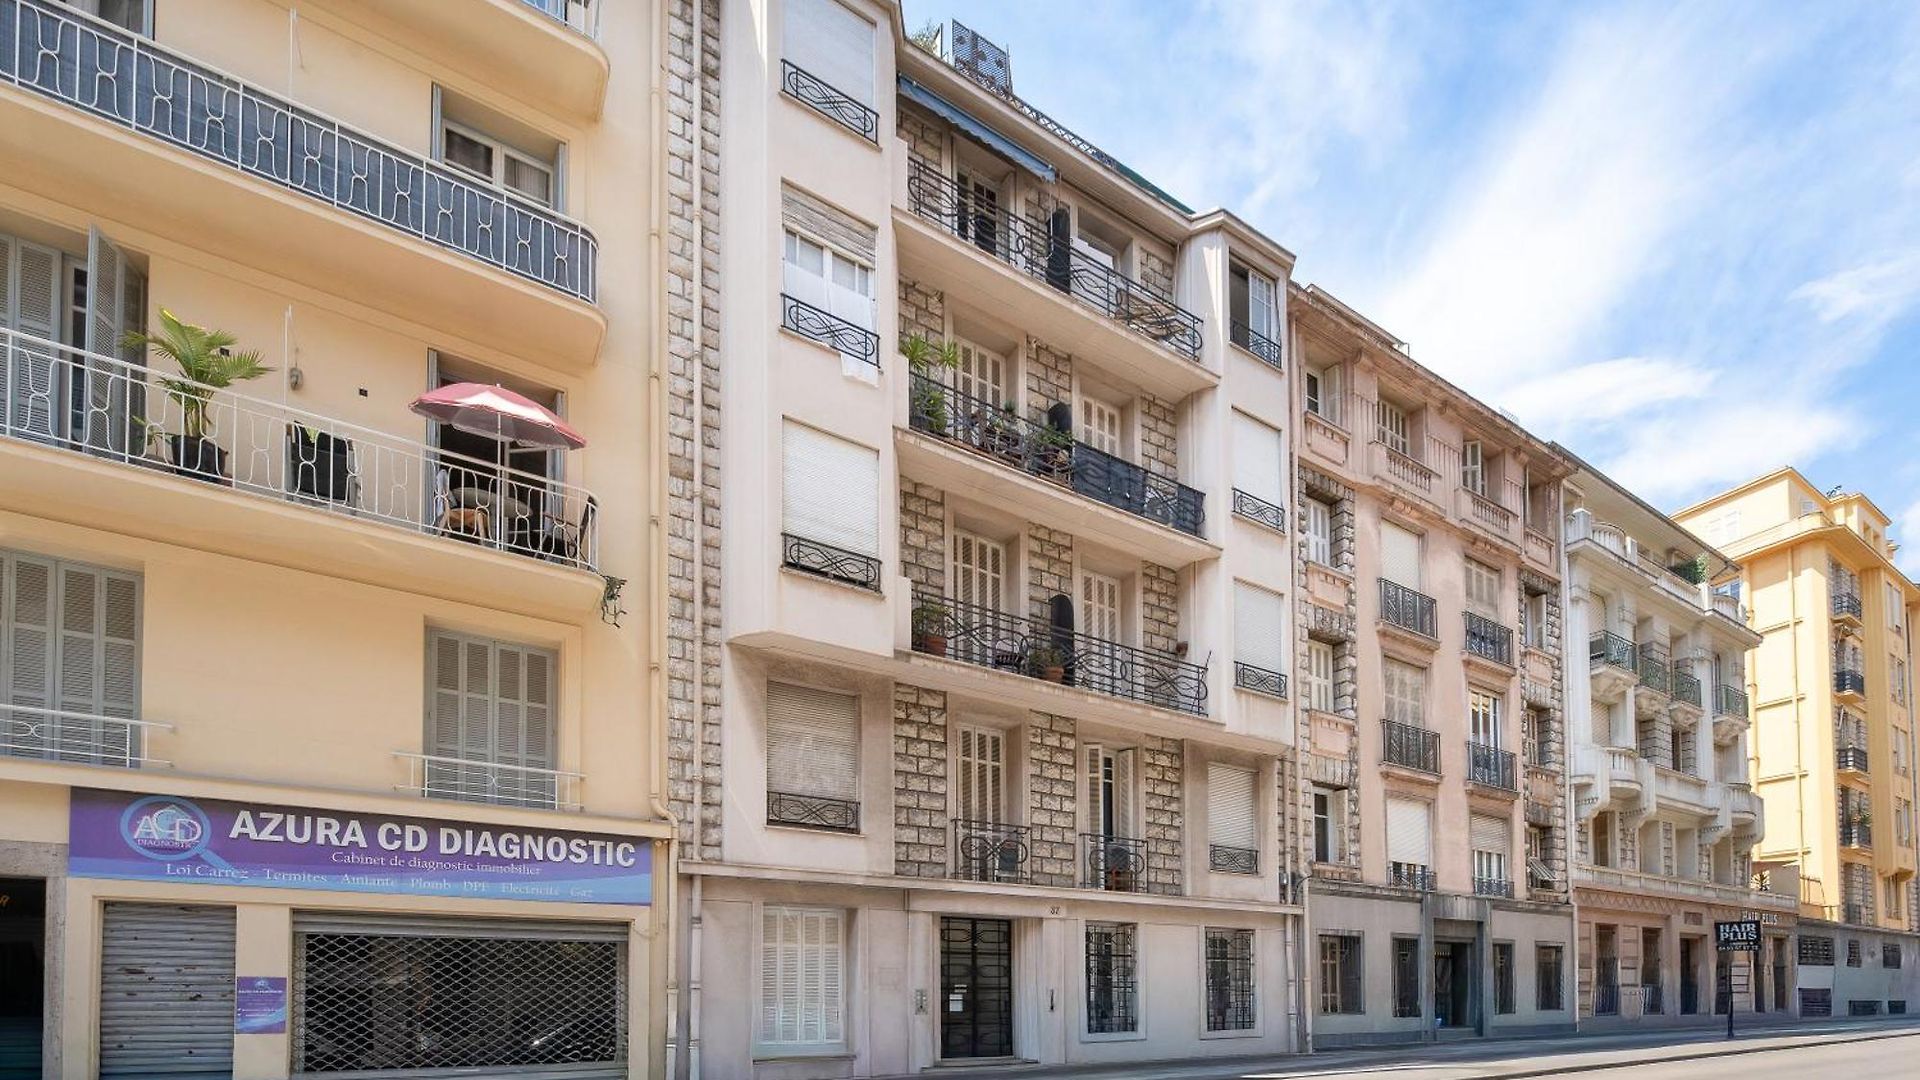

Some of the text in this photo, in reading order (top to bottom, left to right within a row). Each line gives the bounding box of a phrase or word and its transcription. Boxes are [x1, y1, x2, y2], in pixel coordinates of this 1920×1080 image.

[229, 810, 636, 868] AZURA CD DIAGNOSTIC
[331, 851, 542, 875] Cabinet de diagnostic immobilier
[165, 863, 191, 876] Loi
[195, 864, 249, 879] Carrez
[262, 867, 328, 883] Termites
[341, 873, 396, 887] Amiante
[410, 877, 452, 890] Plomb
[570, 887, 593, 898] Gaz
[1719, 923, 1757, 933] HAIR
[1719, 931, 1757, 941] PLUS
